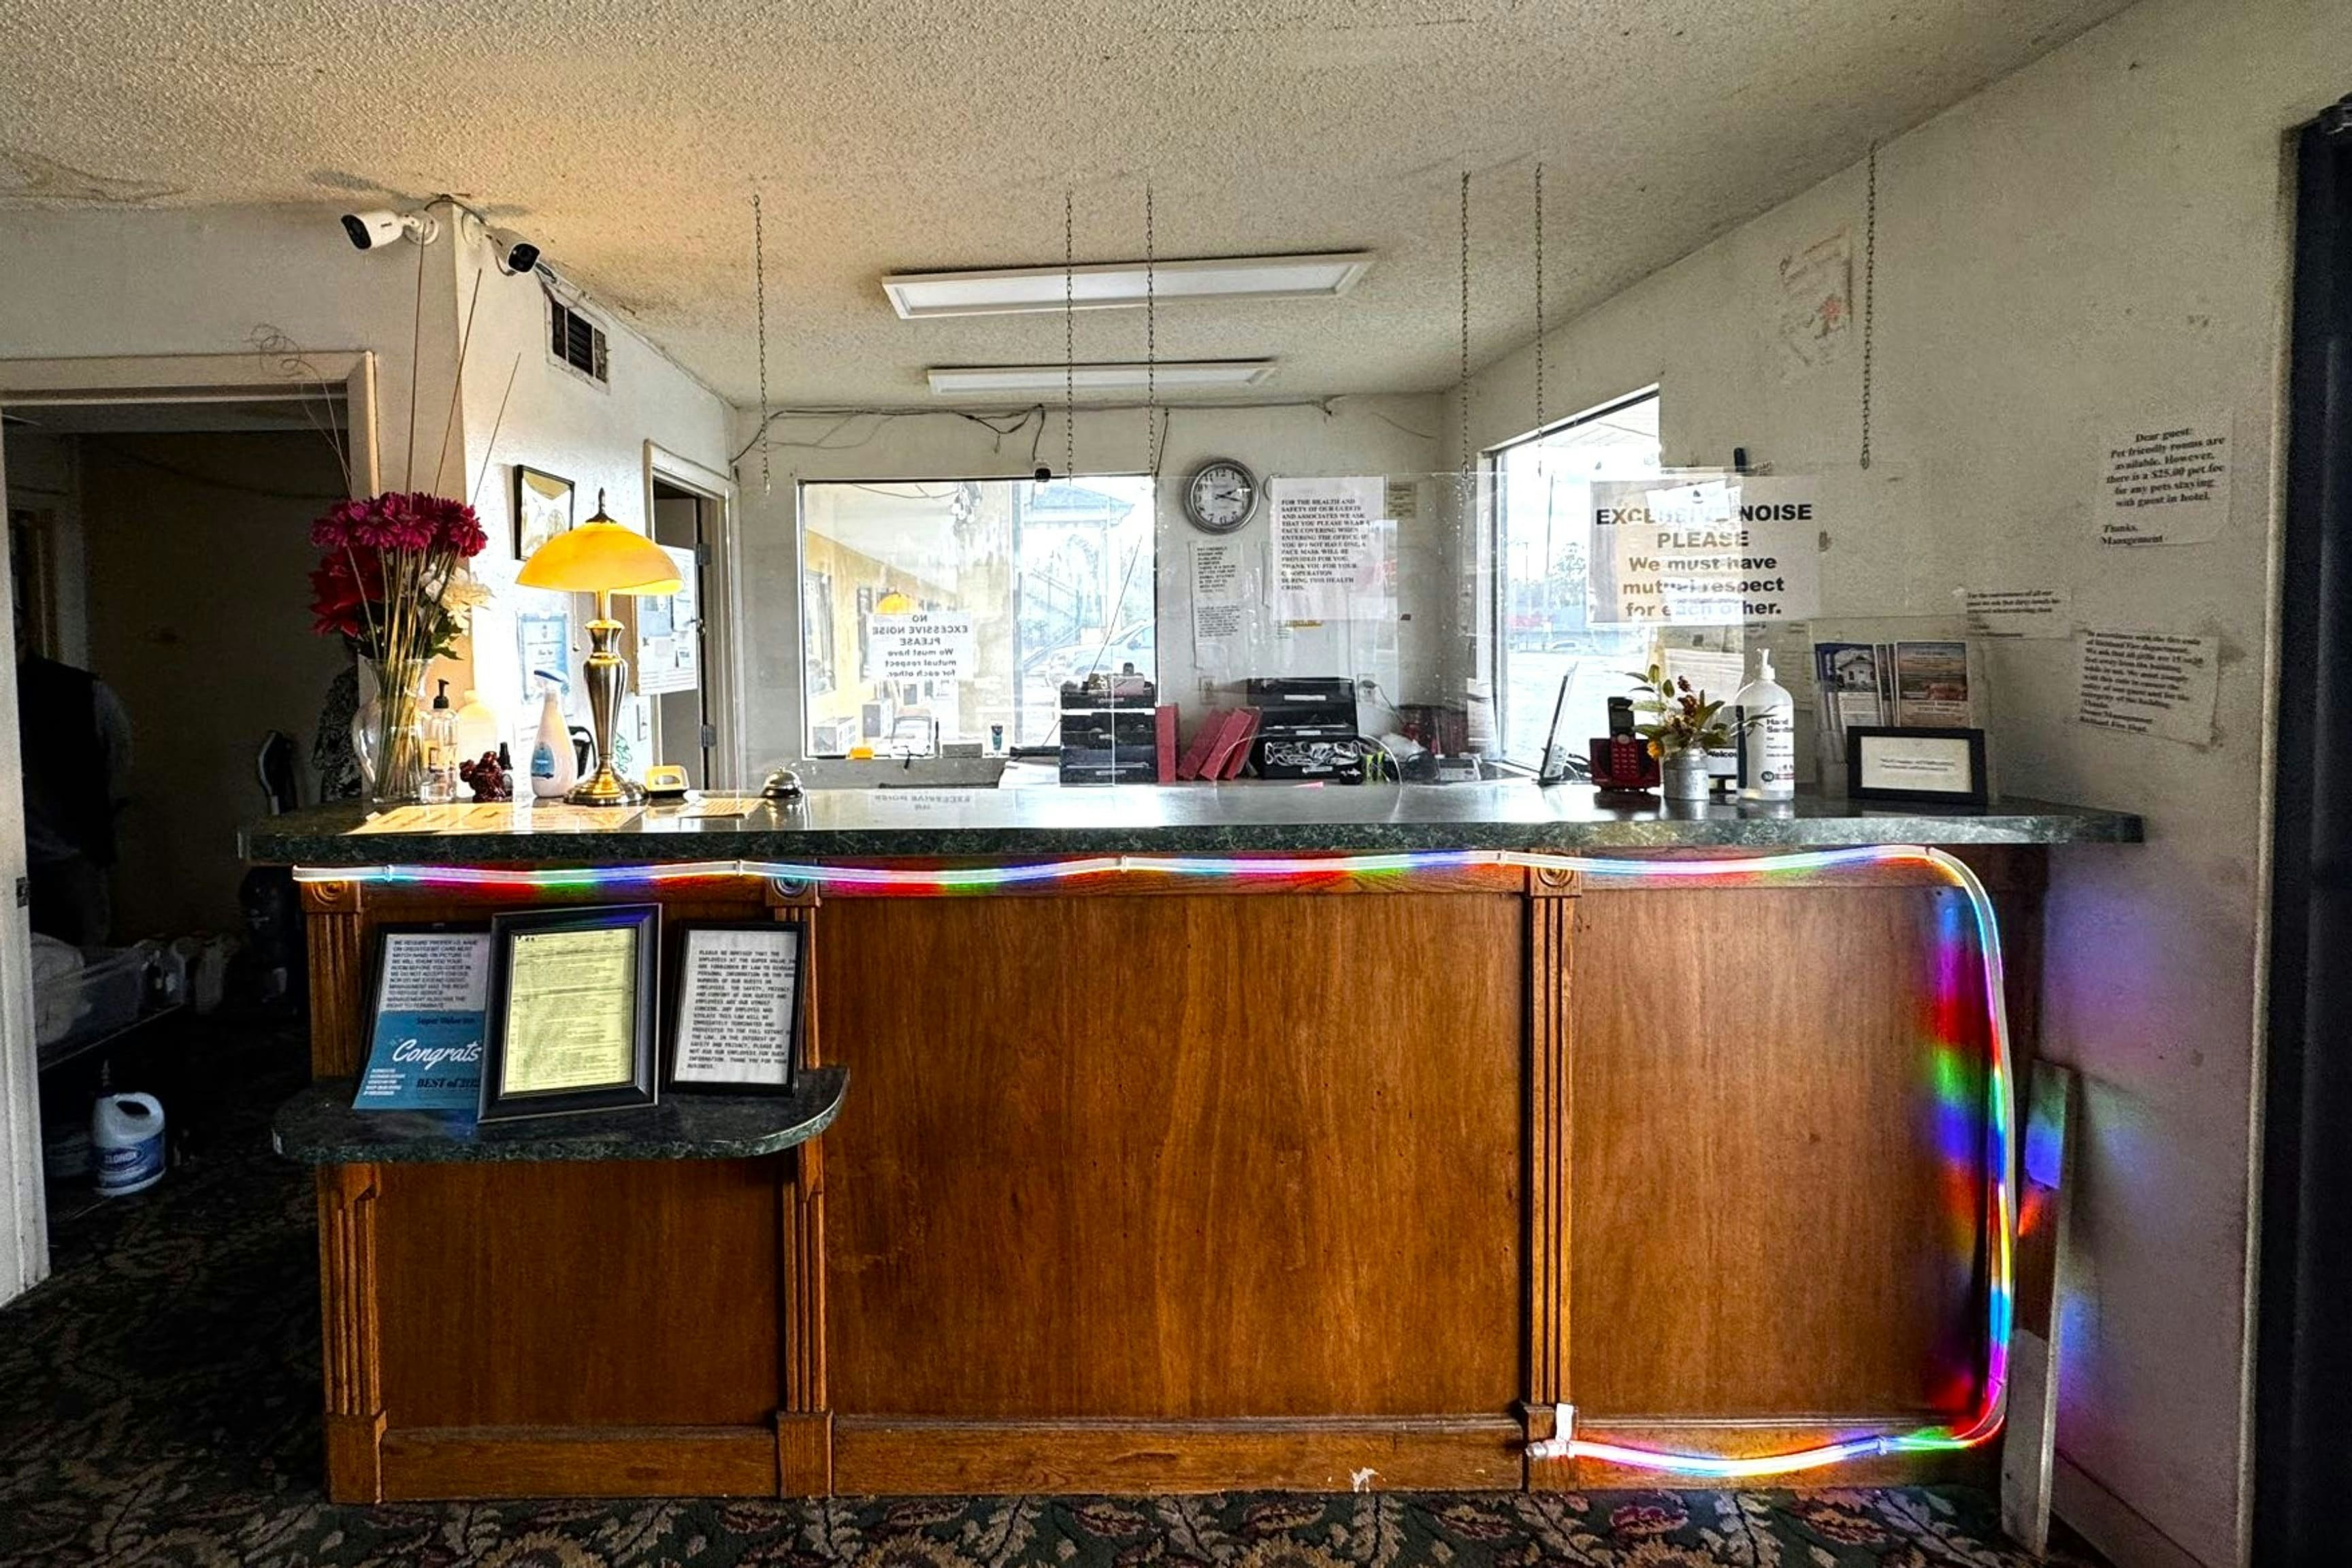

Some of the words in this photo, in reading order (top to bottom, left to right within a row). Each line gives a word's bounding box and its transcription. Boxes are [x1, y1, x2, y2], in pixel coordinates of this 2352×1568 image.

[2136, 433, 2159, 442] Dear
[2128, 444, 2166, 457] friendly
[2170, 440, 2203, 451] rooms
[2206, 438, 2226, 446] are
[1740, 504, 1812, 521] NOISE
[1657, 531, 1750, 548] PLEASE
[1629, 557, 1661, 571] We
[1667, 557, 1720, 570] must
[1727, 556, 1778, 570] have
[1626, 602, 1655, 617] for
[392, 1039, 483, 1071] Congrats
